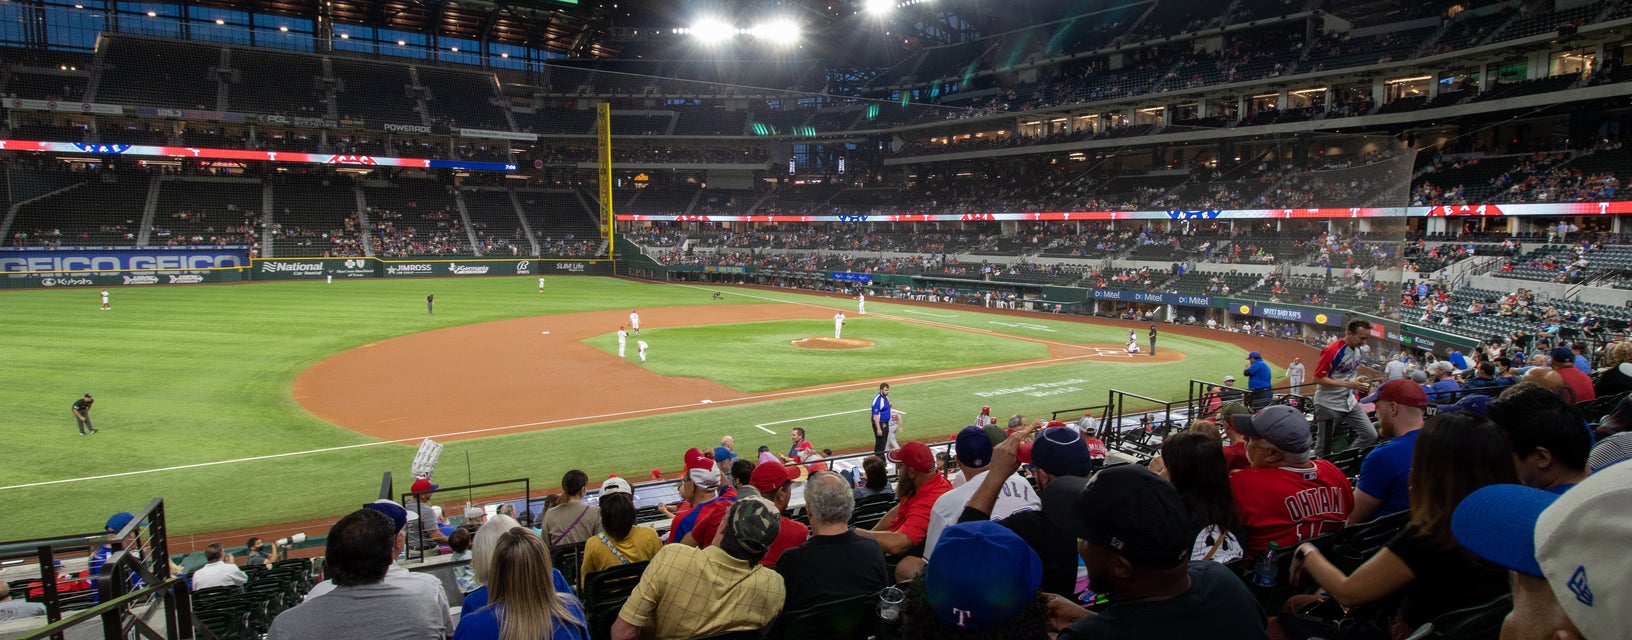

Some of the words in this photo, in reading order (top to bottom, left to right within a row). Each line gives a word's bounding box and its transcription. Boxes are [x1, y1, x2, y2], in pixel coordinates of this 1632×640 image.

[384, 123, 431, 133] POWERADE
[267, 151, 277, 160] T
[1350, 208, 1360, 217] T
[1599, 202, 1609, 214] T
[1284, 209, 1292, 218] T
[0, 257, 121, 278] GEICO
[129, 255, 241, 275] GEICO
[276, 262, 324, 271] National
[1103, 291, 1120, 299] Mitel
[1144, 294, 1162, 302] Mitel
[1188, 297, 1208, 305] Mitel
[1002, 481, 1029, 501] OLI
[1285, 486, 1344, 522] OHTAN
[952, 607, 971, 627] T
